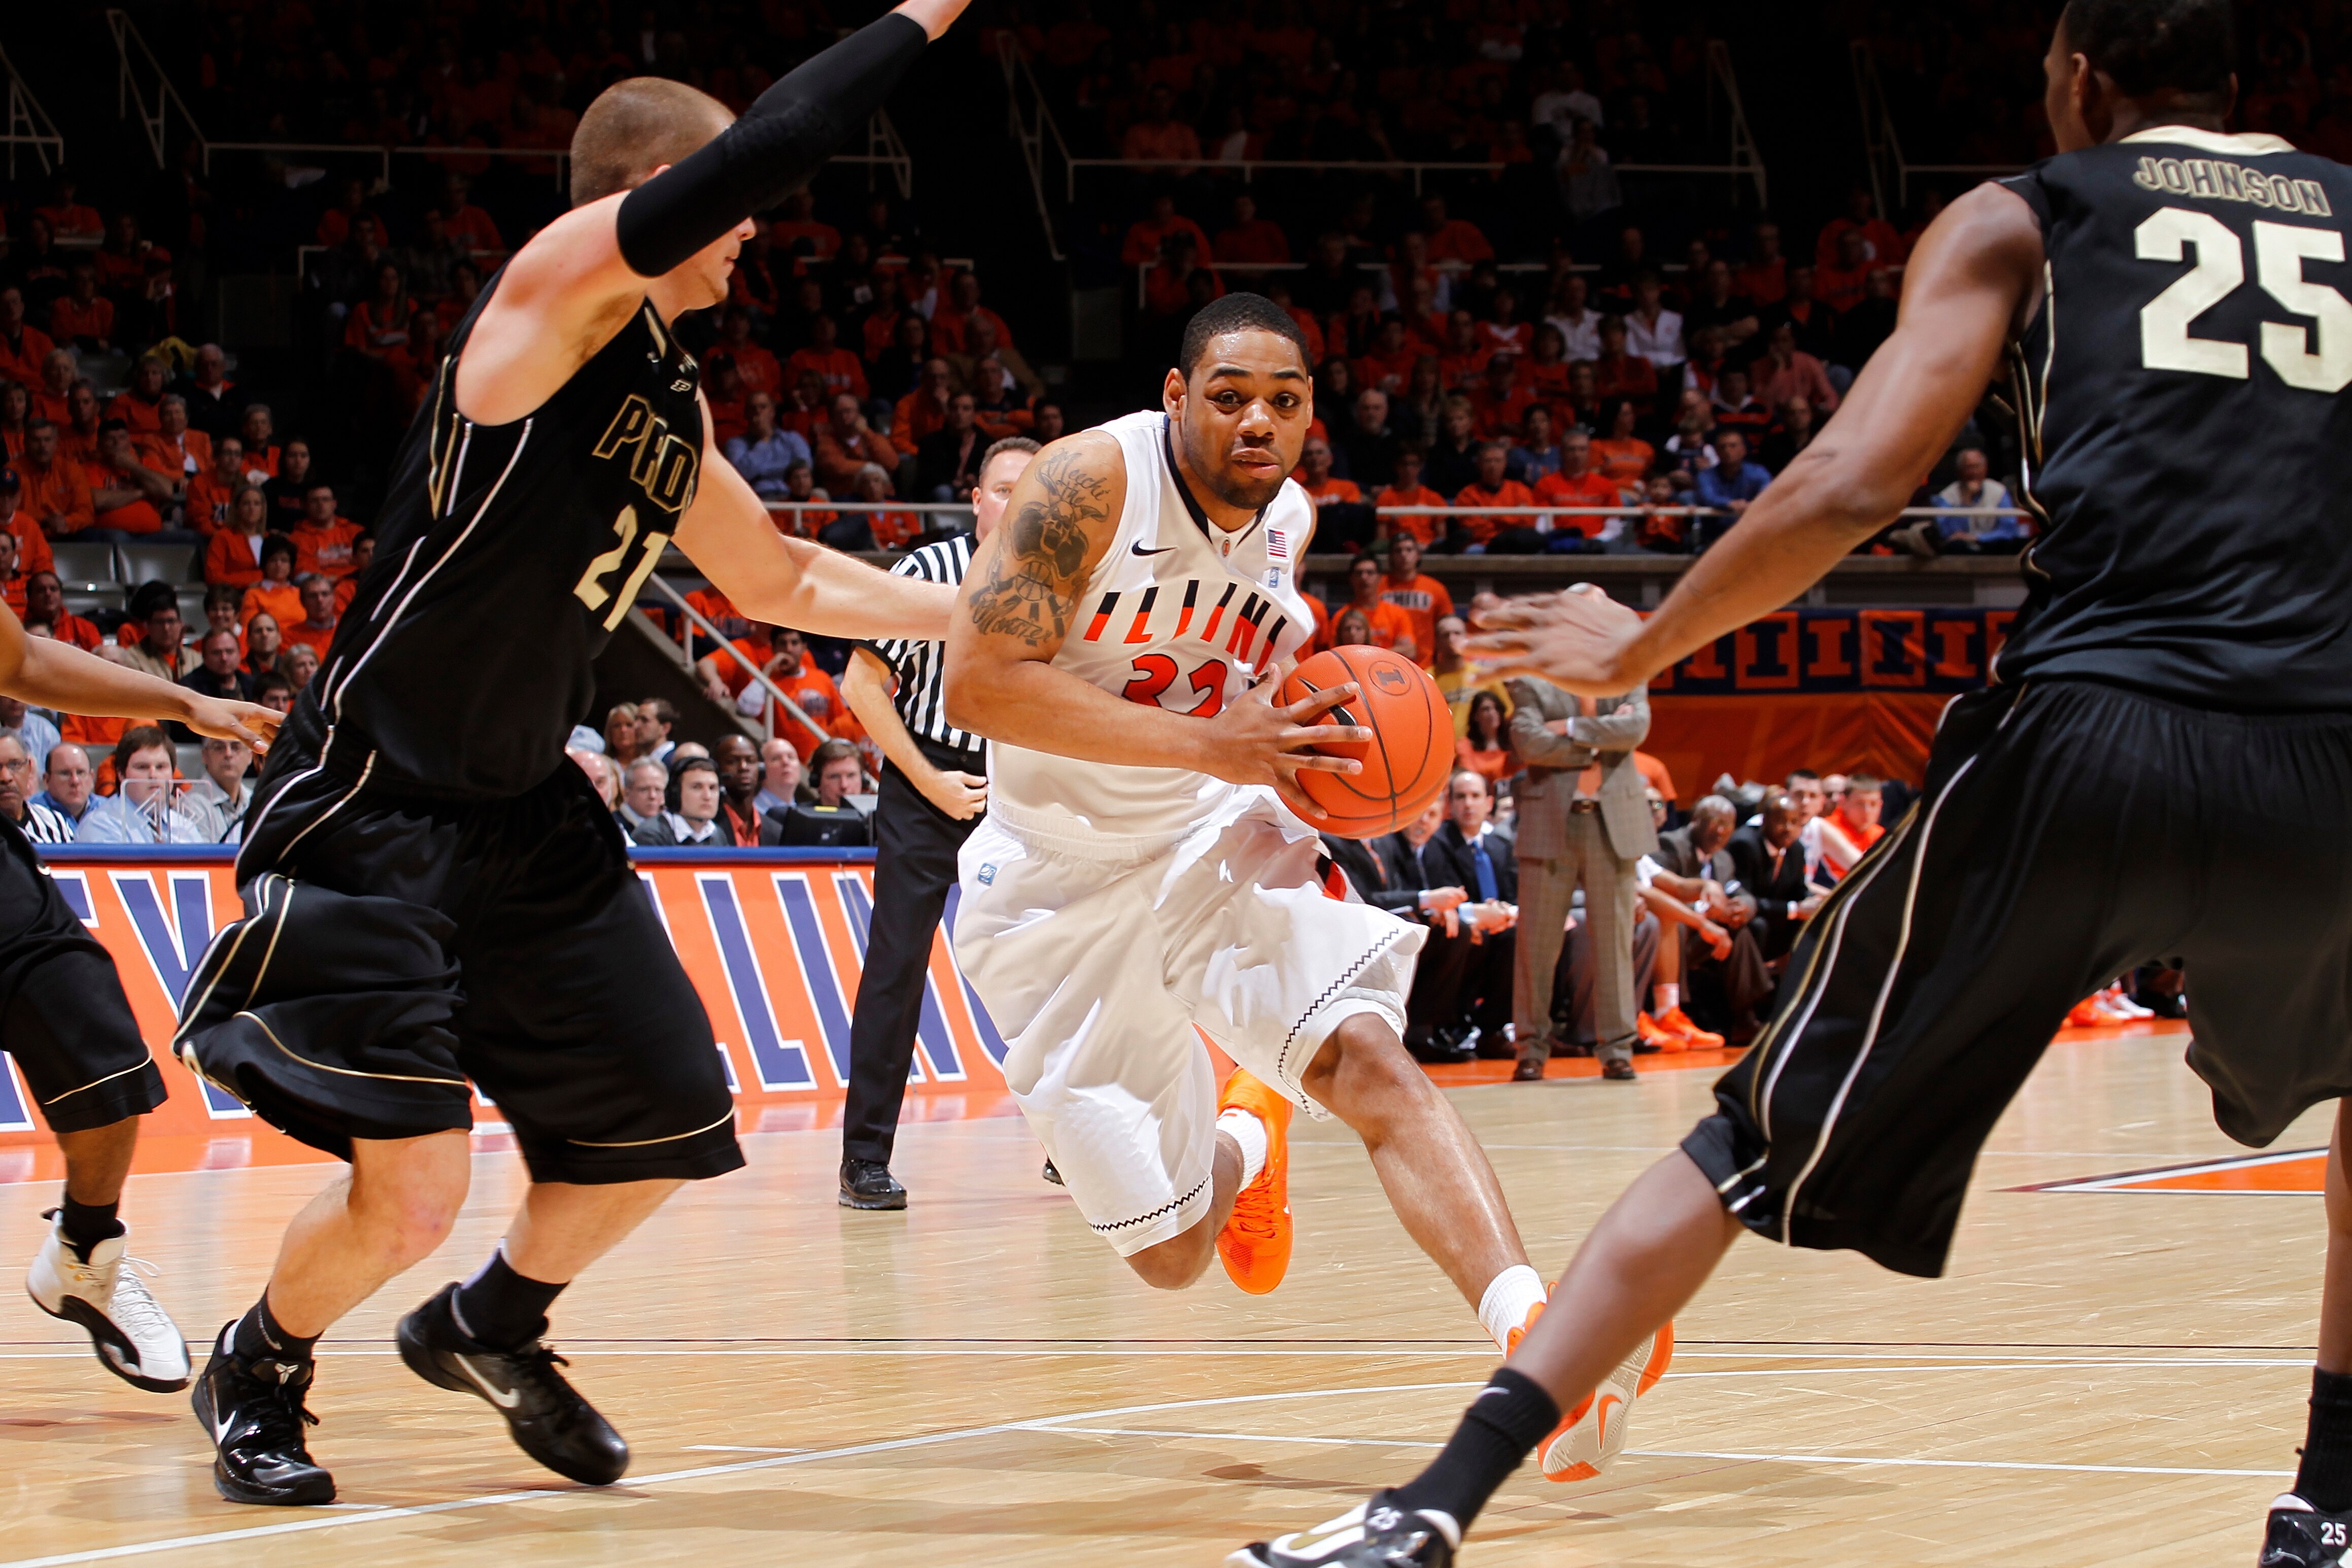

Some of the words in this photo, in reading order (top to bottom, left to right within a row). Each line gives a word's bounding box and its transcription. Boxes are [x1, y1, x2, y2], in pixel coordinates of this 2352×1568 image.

[2133, 156, 2333, 217] JOHNSON
[2134, 206, 2352, 394] 25
[670, 379, 692, 392] P
[573, 503, 669, 632] 21
[1121, 653, 1228, 718] 32
[1367, 1506, 1404, 1531] 25
[2320, 1521, 2347, 1546] 25
